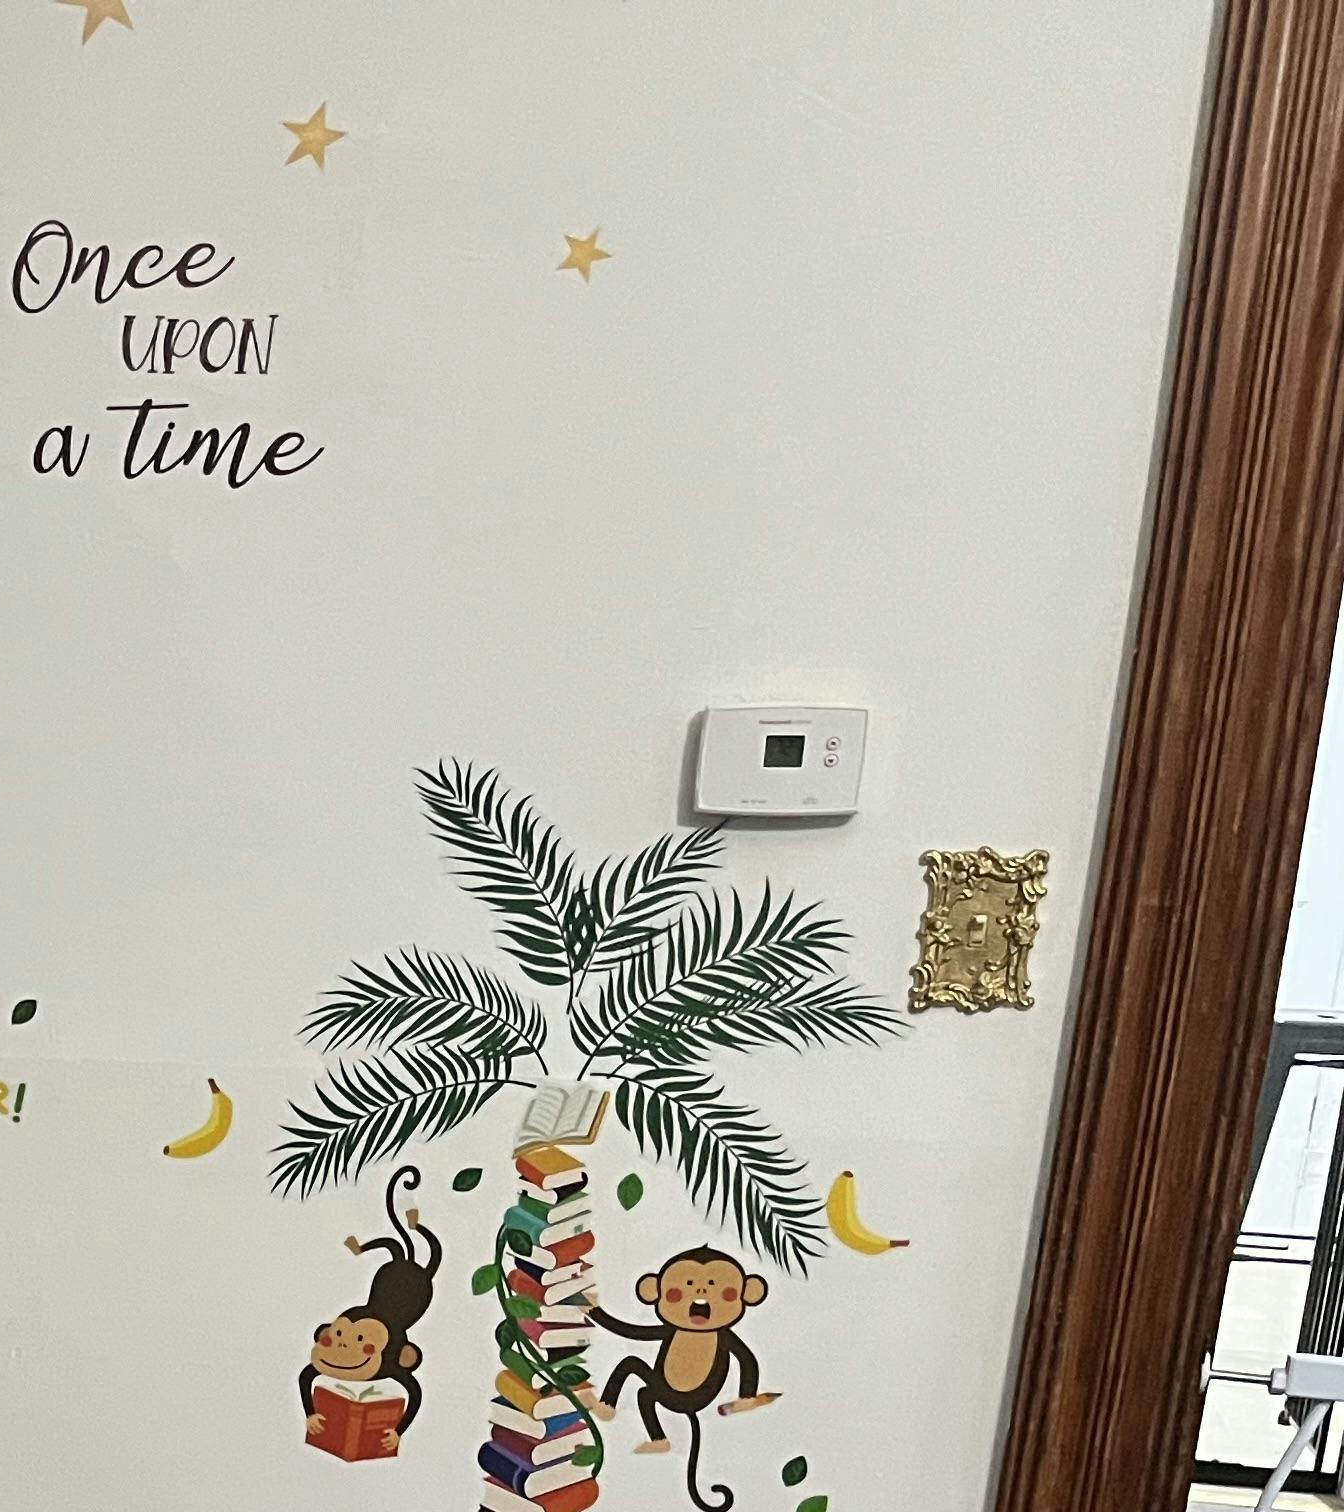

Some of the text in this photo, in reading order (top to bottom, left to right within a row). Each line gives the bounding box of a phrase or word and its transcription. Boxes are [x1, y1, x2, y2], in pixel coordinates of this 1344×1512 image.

[12, 219, 236, 314] Once
[120, 314, 280, 375] UPON
[32, 398, 325, 490] a time
